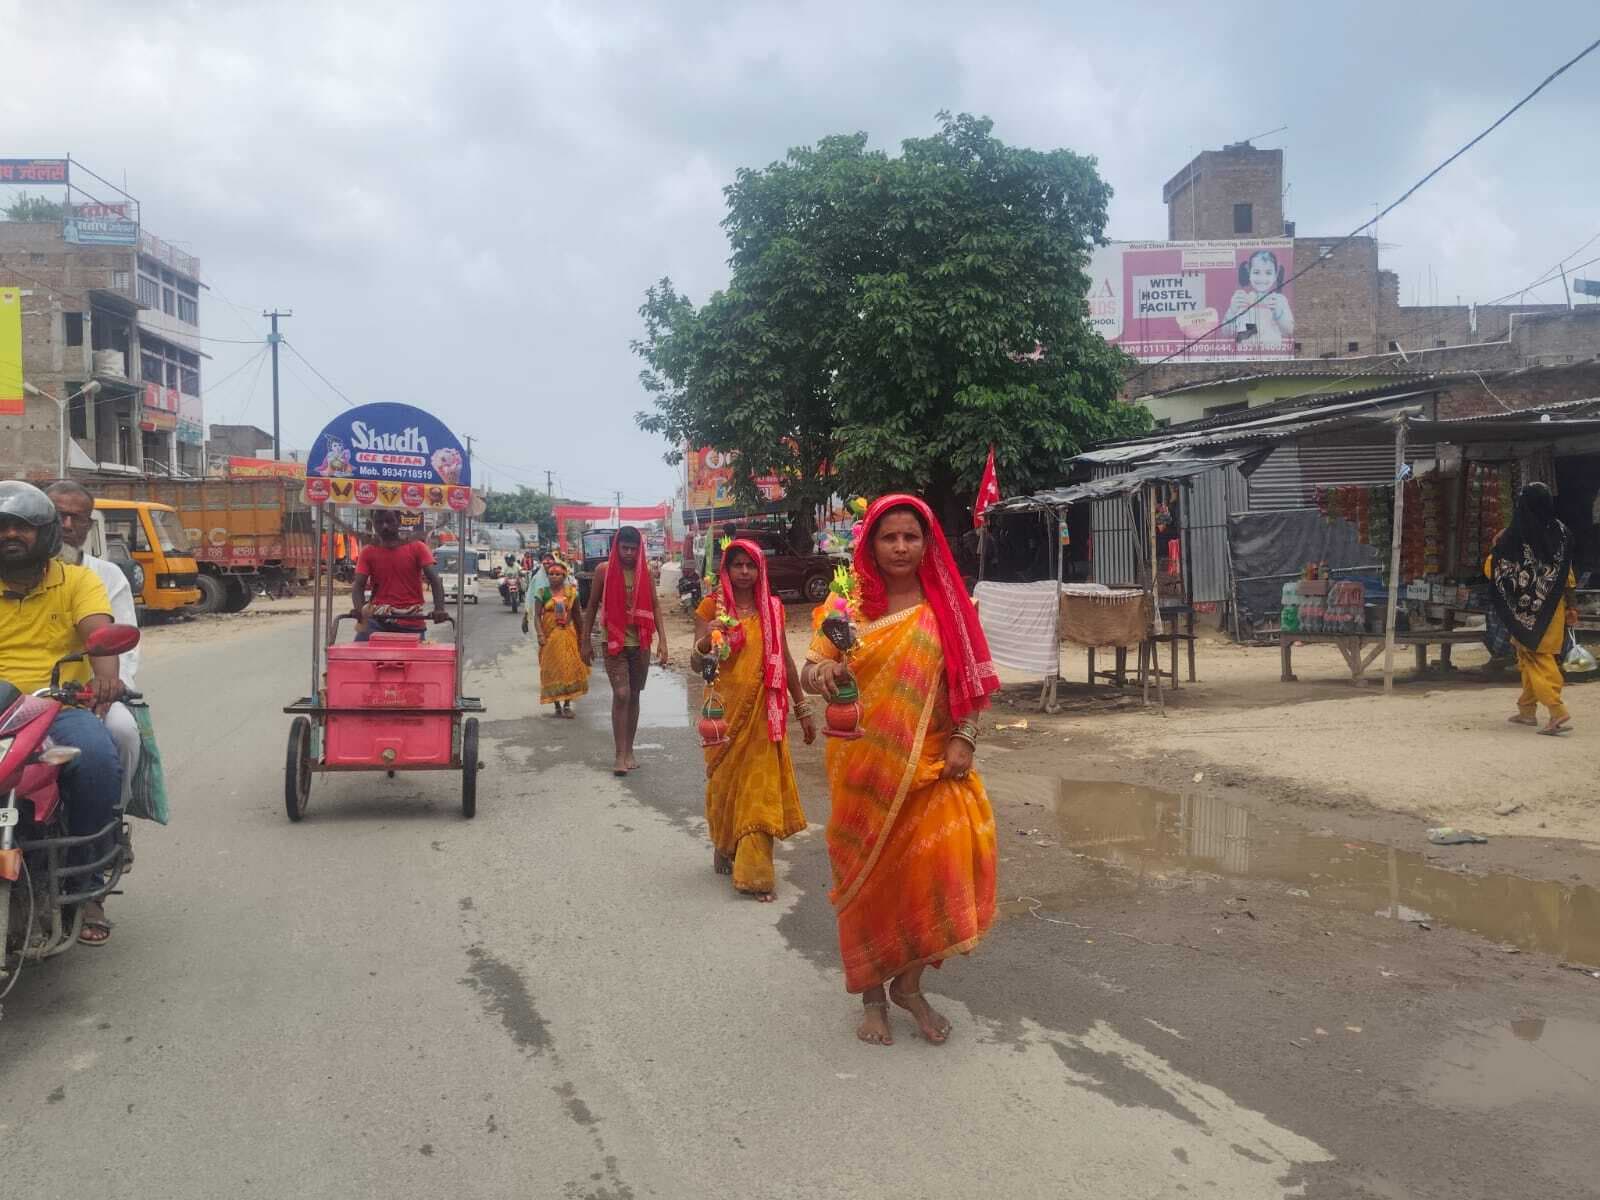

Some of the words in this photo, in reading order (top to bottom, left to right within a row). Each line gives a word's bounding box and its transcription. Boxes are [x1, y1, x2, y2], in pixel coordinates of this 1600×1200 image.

[1150, 279, 1183, 288] WITH
[1142, 290, 1192, 300] HOSTEL
[1140, 302, 1197, 312] FACILITY
[351, 420, 430, 454] Shudh
[359, 453, 377, 462] ICE
[383, 455, 422, 465] CREAM
[359, 466, 380, 476] Mob.
